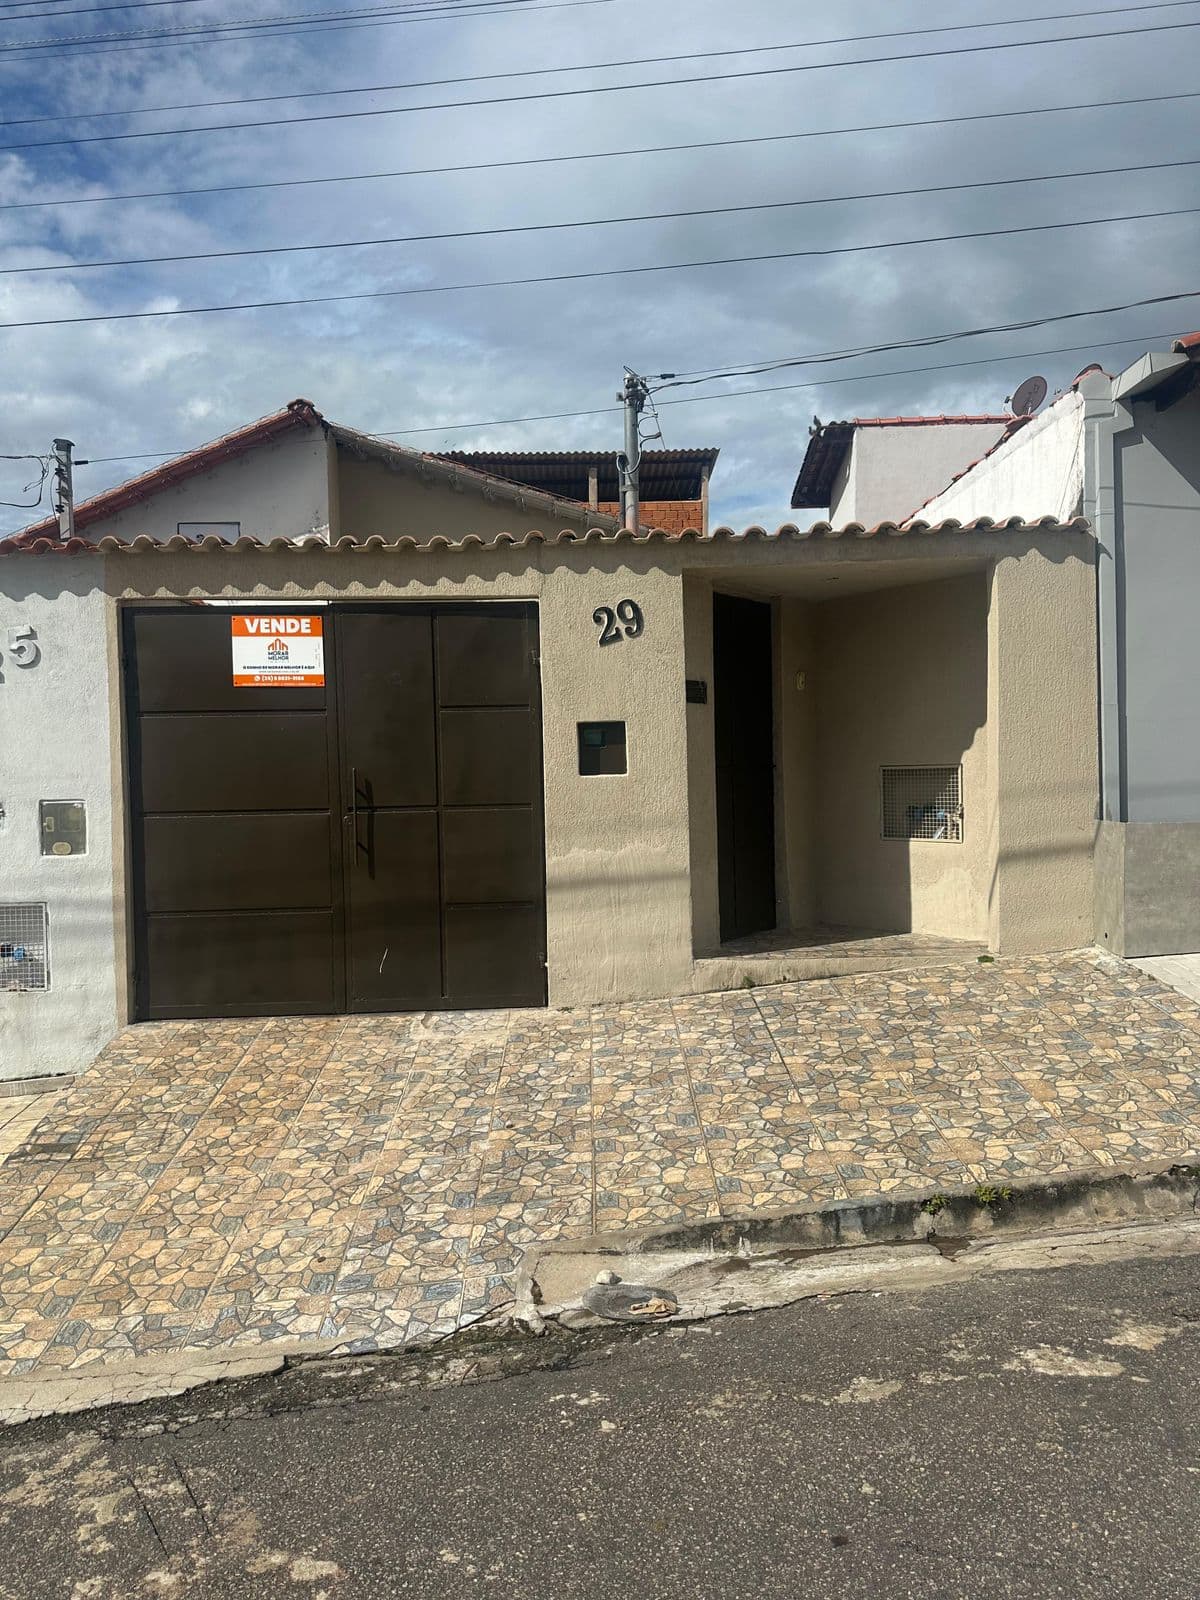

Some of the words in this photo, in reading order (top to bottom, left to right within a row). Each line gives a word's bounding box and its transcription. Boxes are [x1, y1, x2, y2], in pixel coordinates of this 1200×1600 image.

[245, 618, 312, 634] VENDE
[593, 599, 644, 647] 29
[0, 625, 41, 682] 5
